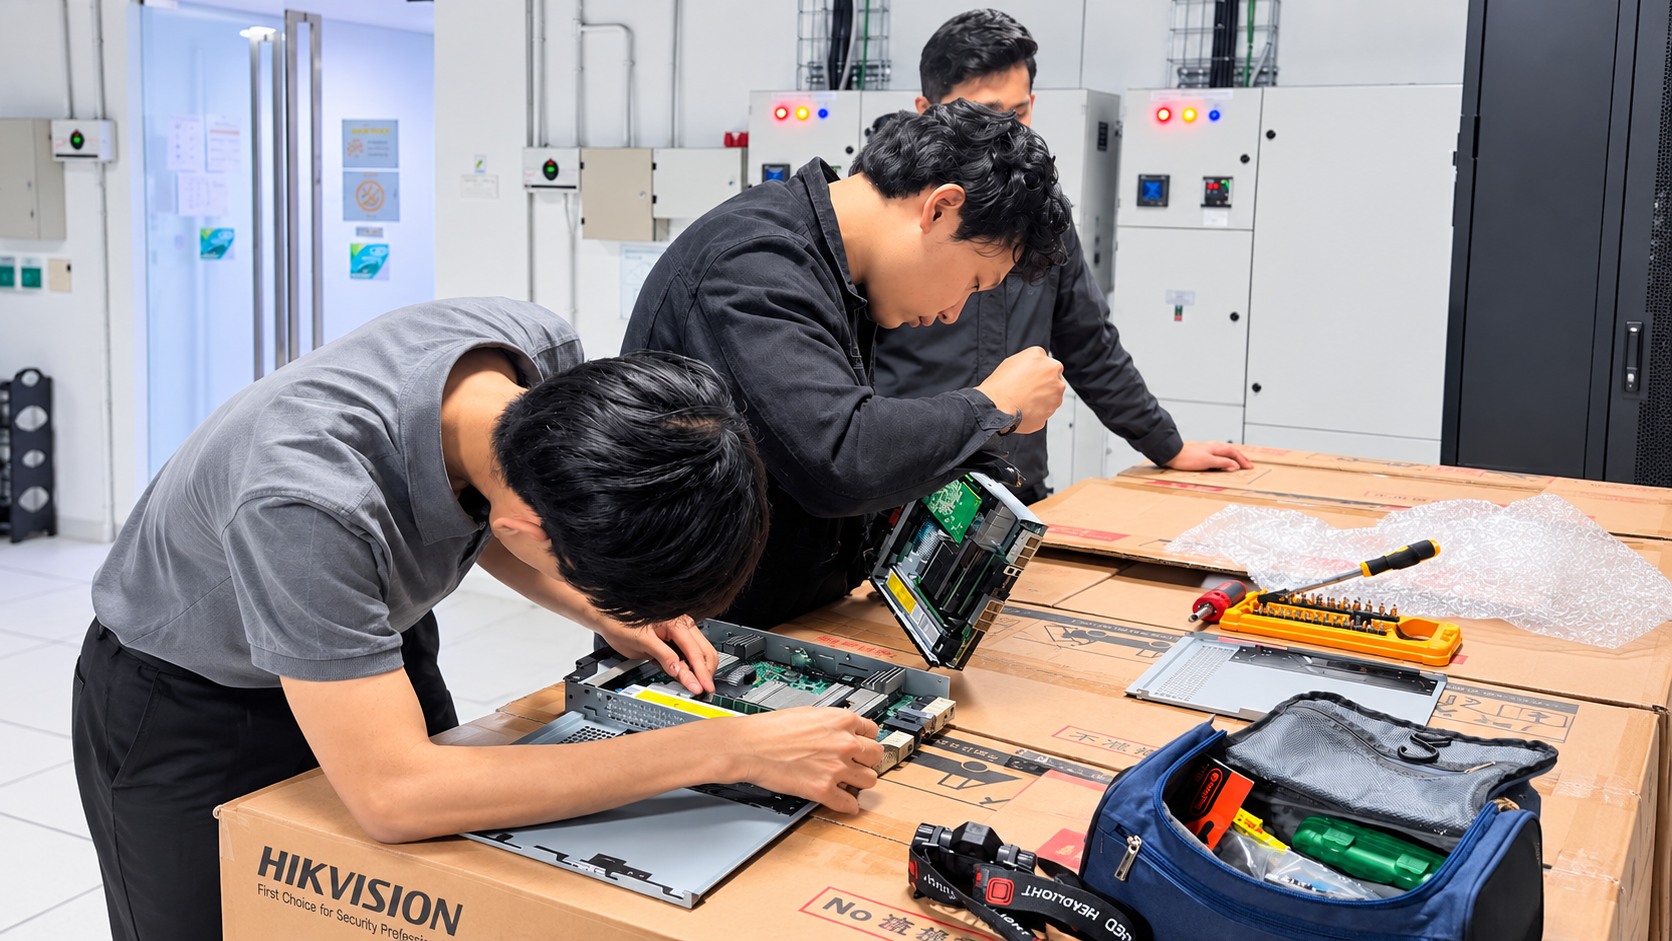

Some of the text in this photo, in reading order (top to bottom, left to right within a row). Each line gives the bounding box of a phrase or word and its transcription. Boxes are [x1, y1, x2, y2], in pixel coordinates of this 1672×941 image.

[257, 845, 463, 936] HIKVISION
[257, 883, 279, 901] First
[282, 891, 317, 912] Choice
[319, 903, 334, 918] for
[336, 908, 378, 935] Security
